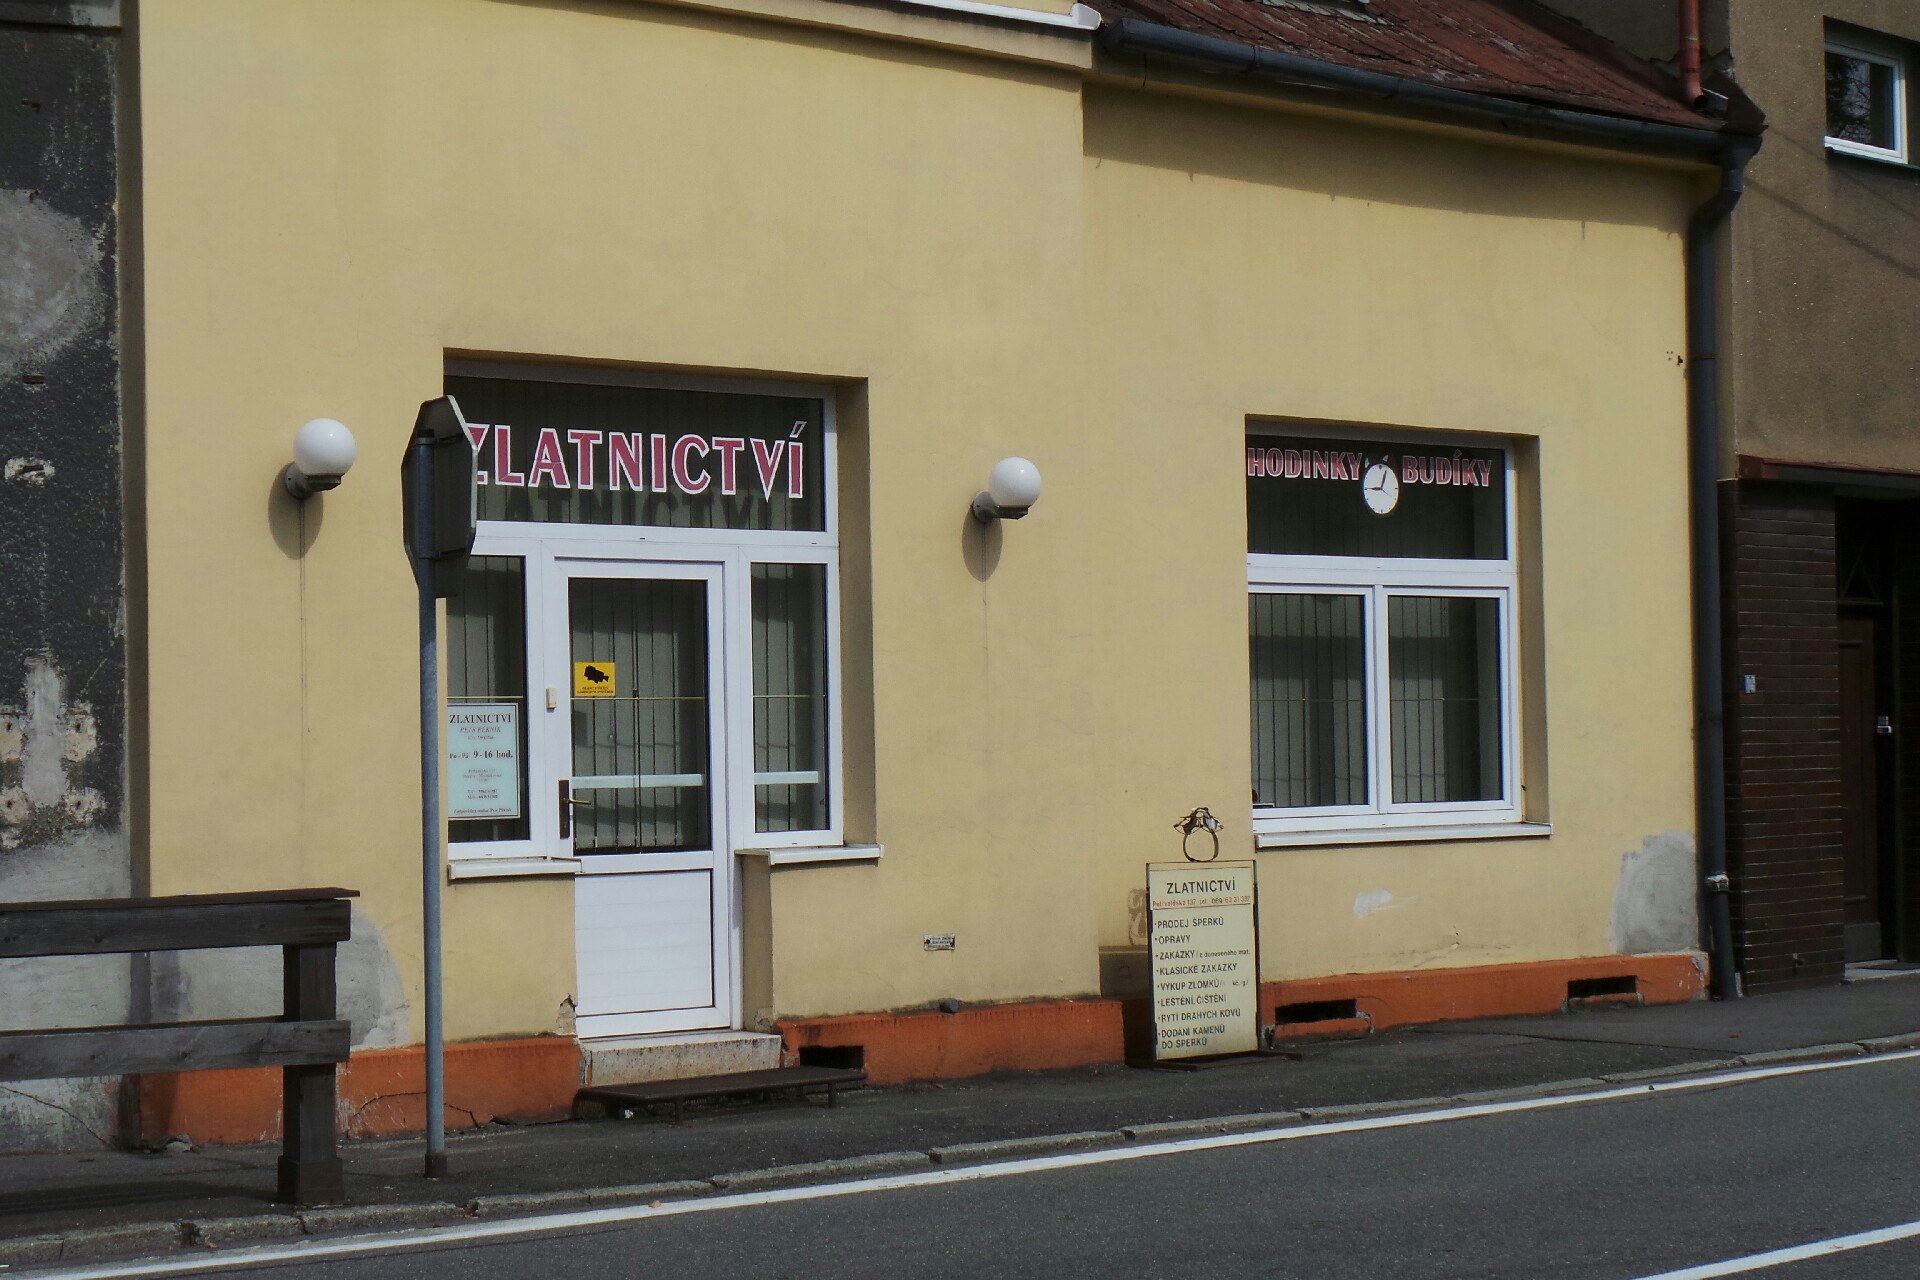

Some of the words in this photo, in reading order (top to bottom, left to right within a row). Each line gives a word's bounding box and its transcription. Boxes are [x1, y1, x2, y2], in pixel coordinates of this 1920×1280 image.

[467, 420, 807, 502] ZLATNICTVÍ
[1247, 447, 1363, 481] HODINKY
[1402, 448, 1492, 487] BUDÍKY
[449, 713, 511, 724] ZLATNICTVÍ
[496, 750, 513, 758] hod.
[1166, 877, 1236, 894] ZLATNICTVÍ
[1157, 919, 1189, 929] PRODEJ
[1192, 916, 1224, 927] ŠPERKŮ
[1158, 934, 1191, 944] OPRAVY
[1159, 964, 1198, 976] KLASICKÉ
[1201, 963, 1237, 974] ZAKÁZKY
[1160, 981, 1186, 991] VÝKUP
[1161, 1013, 1179, 1023] RYTÍ
[1181, 1010, 1217, 1021] DRAHÝCH
[1219, 1008, 1241, 1018] KOVŮ
[1161, 1027, 1190, 1038] DODÁNÍ
[1192, 1024, 1225, 1035] KAMENŮ
[1161, 1040, 1173, 1049] DO
[1175, 1037, 1207, 1048] ŠPERKŮ
